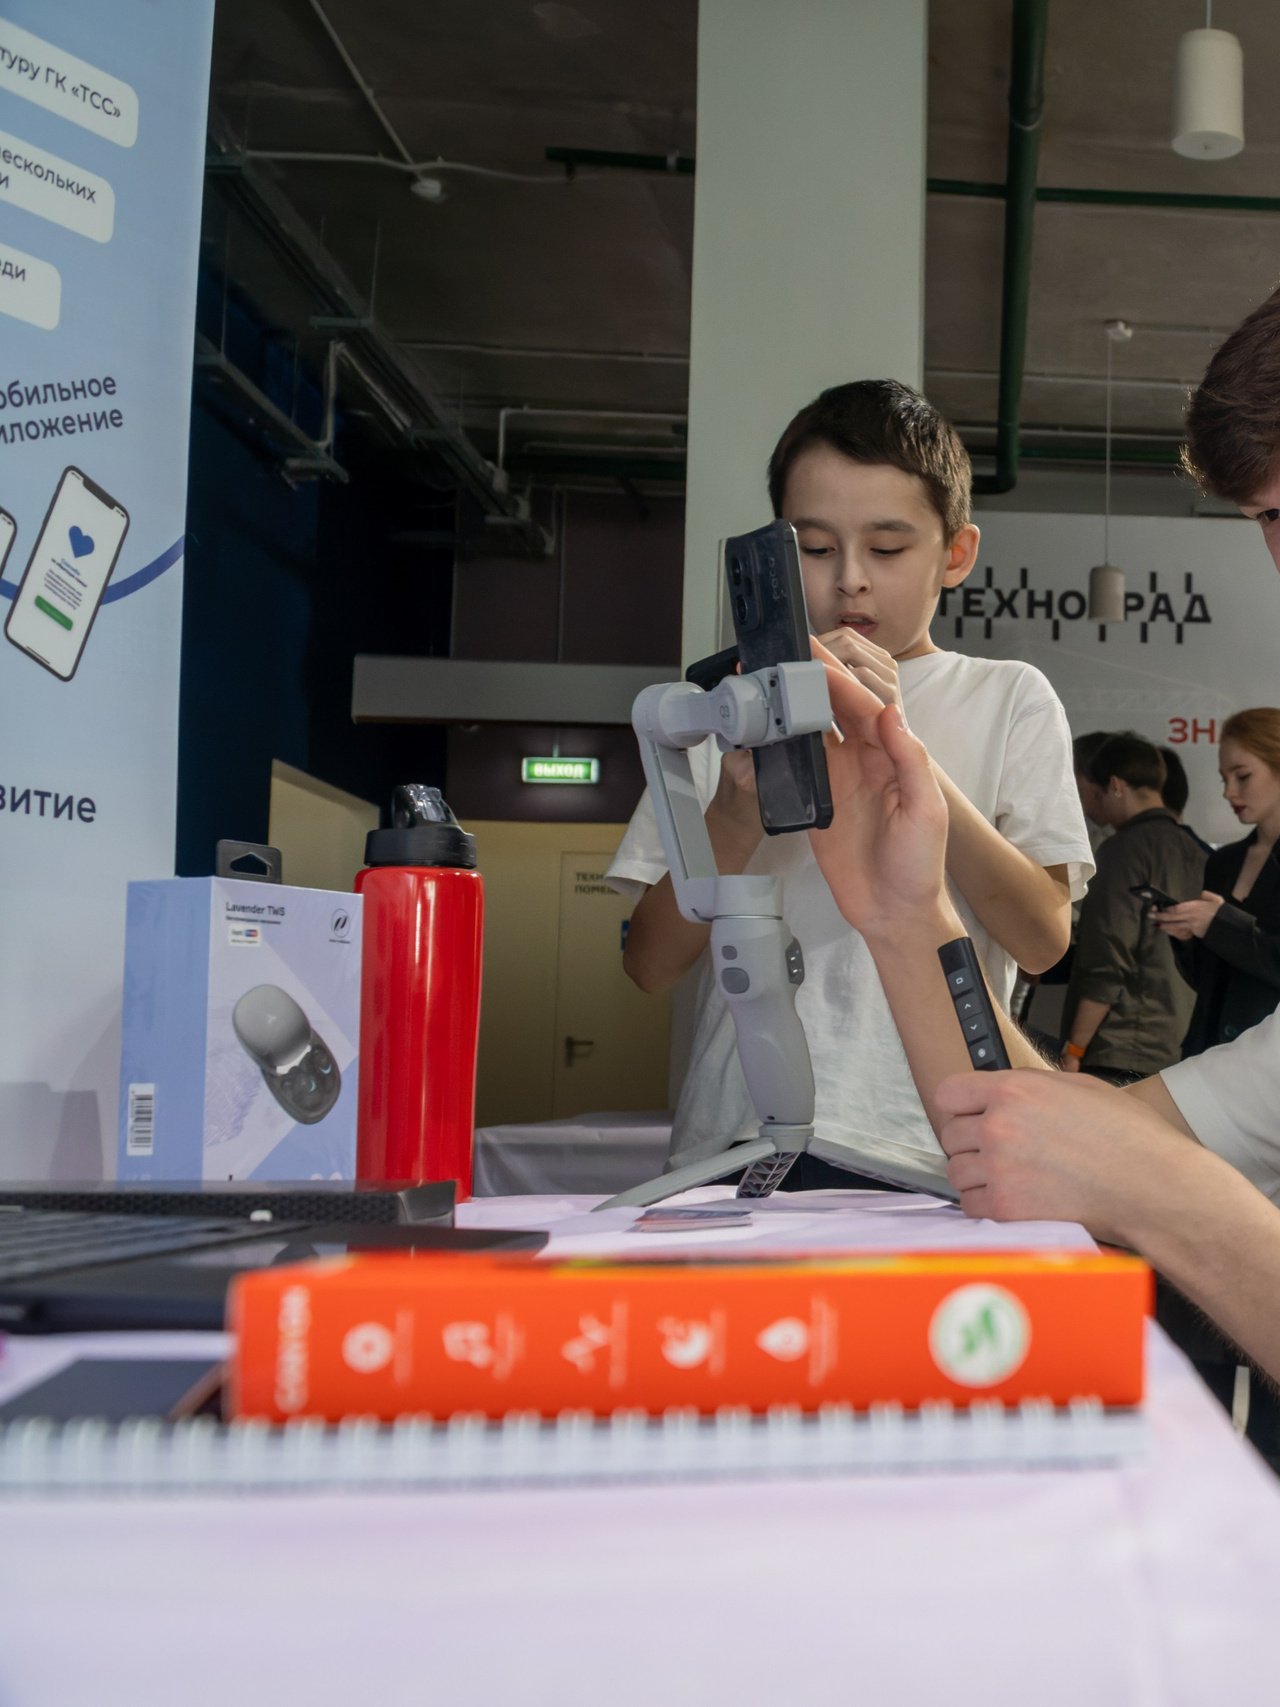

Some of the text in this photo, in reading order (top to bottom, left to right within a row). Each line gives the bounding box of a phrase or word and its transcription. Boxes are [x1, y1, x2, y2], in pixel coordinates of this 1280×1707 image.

[45, 67, 67, 94] ГК
[71, 83, 121, 118] «ТСС»
[0, 146, 96, 203] ескольких
[0, 258, 26, 282] ди
[1167, 717, 1220, 745] ЗН
[533, 762, 584, 779] ВЫХОД
[225, 901, 286, 917] Lavender TWS
